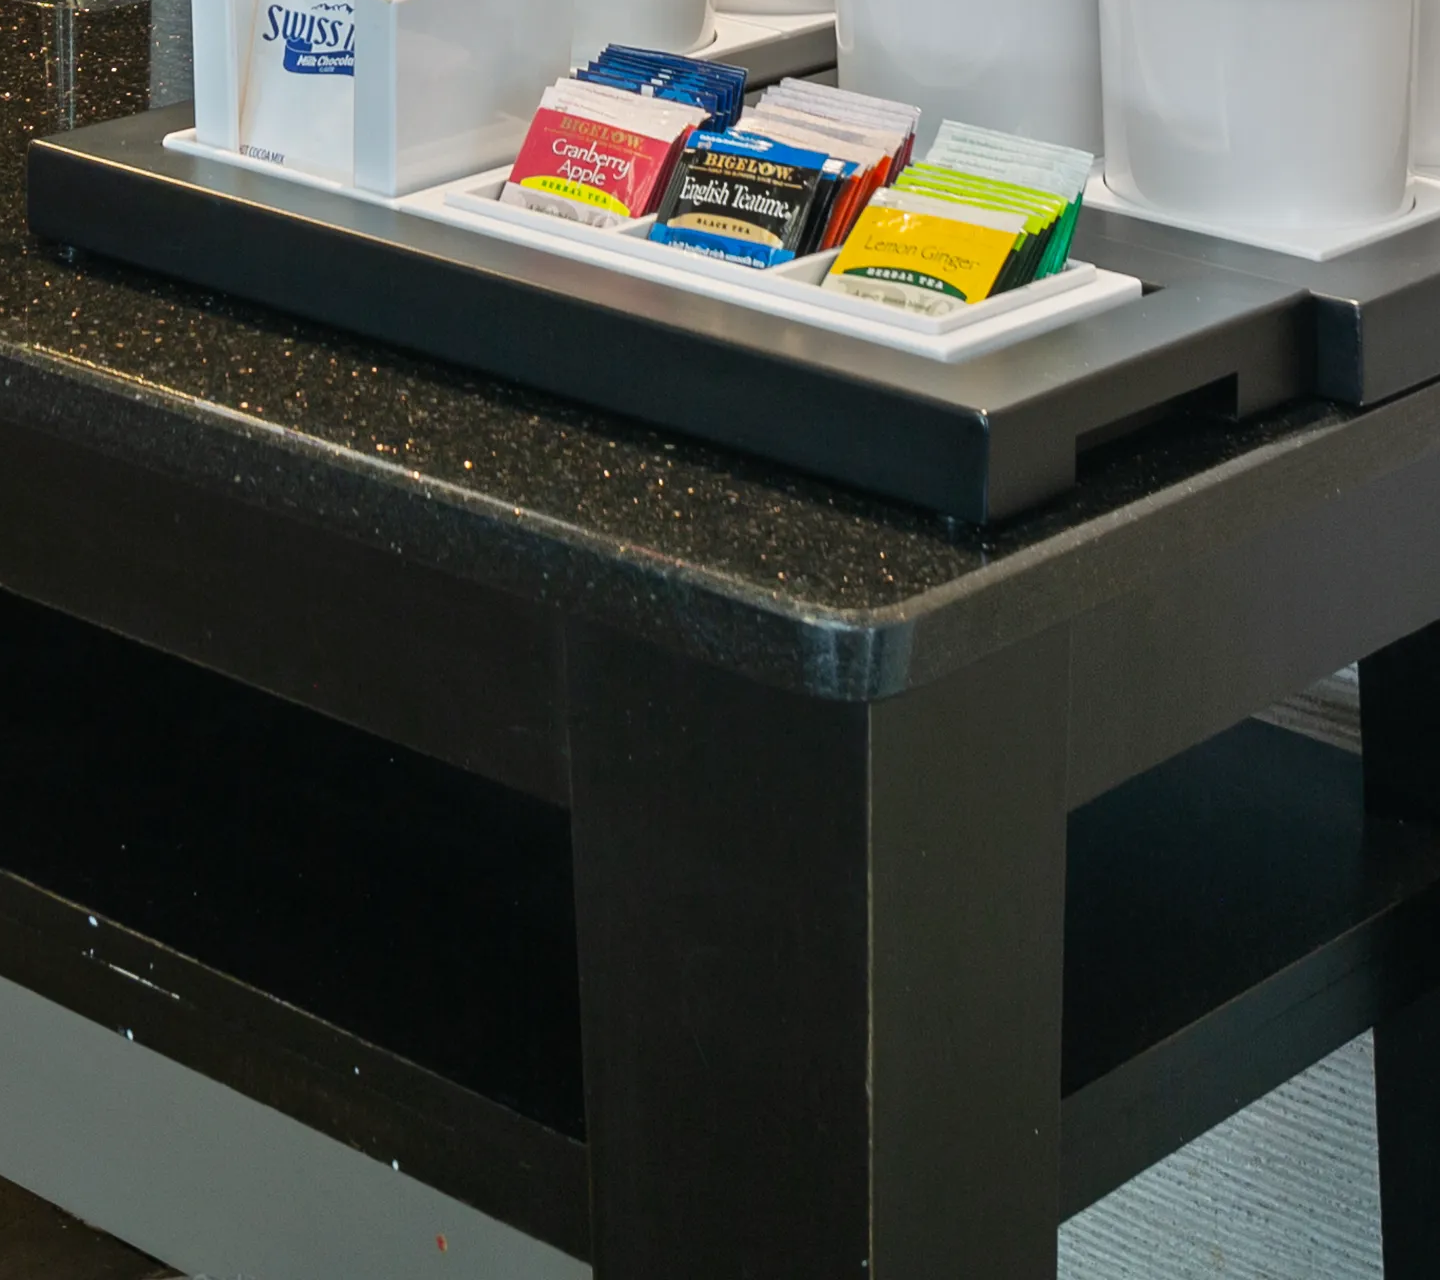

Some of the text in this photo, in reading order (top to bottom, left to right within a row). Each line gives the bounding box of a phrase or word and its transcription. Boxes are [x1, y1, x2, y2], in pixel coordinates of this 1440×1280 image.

[262, 4, 343, 48] SWISS
[296, 54, 317, 68] Milk
[559, 116, 641, 151] BIGELOW
[249, 146, 270, 162] COCOA
[551, 138, 632, 181] Cranberry
[704, 152, 794, 181] BIGELOW
[557, 159, 607, 190] Apple
[541, 180, 608, 205] HERBAL TEA
[679, 176, 729, 207] English
[730, 184, 790, 219] Teatime
[697, 217, 751, 236] BLACK TEA
[863, 235, 980, 273] Lemon Ginger
[918, 275, 944, 290] TEA
